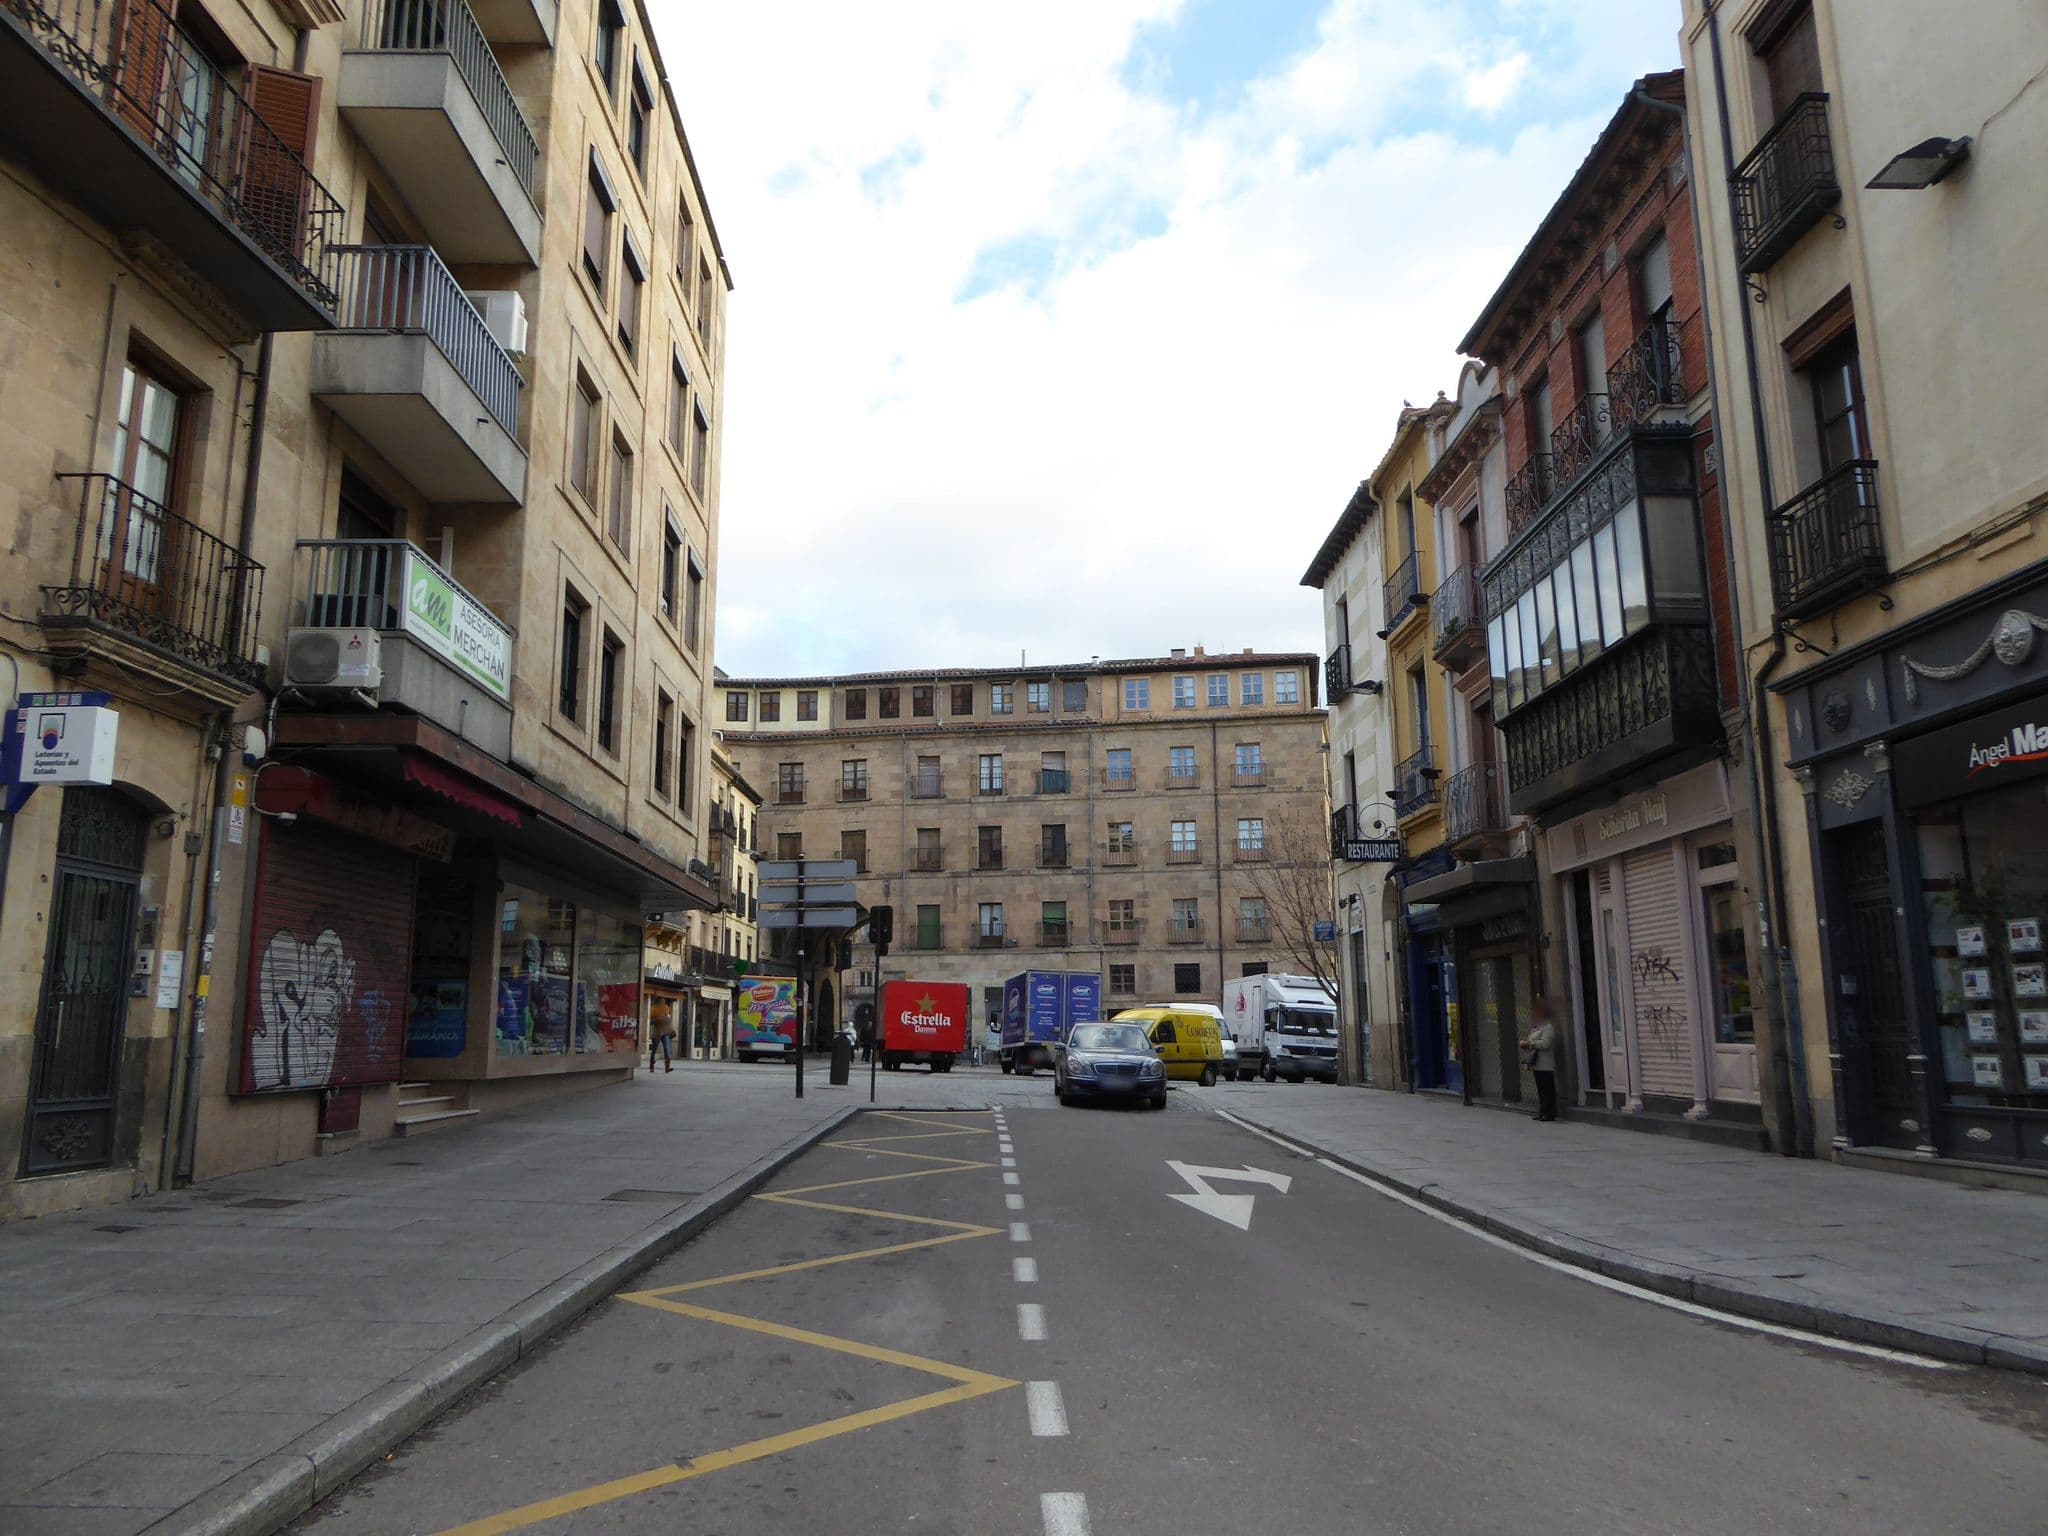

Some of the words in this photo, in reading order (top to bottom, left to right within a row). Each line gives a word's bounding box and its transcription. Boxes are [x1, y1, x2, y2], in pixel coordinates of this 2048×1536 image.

[1969, 736, 2011, 768] Ángel
[1347, 843, 1399, 859] RESTAURANTE
[901, 1010, 951, 1026] Estrella
